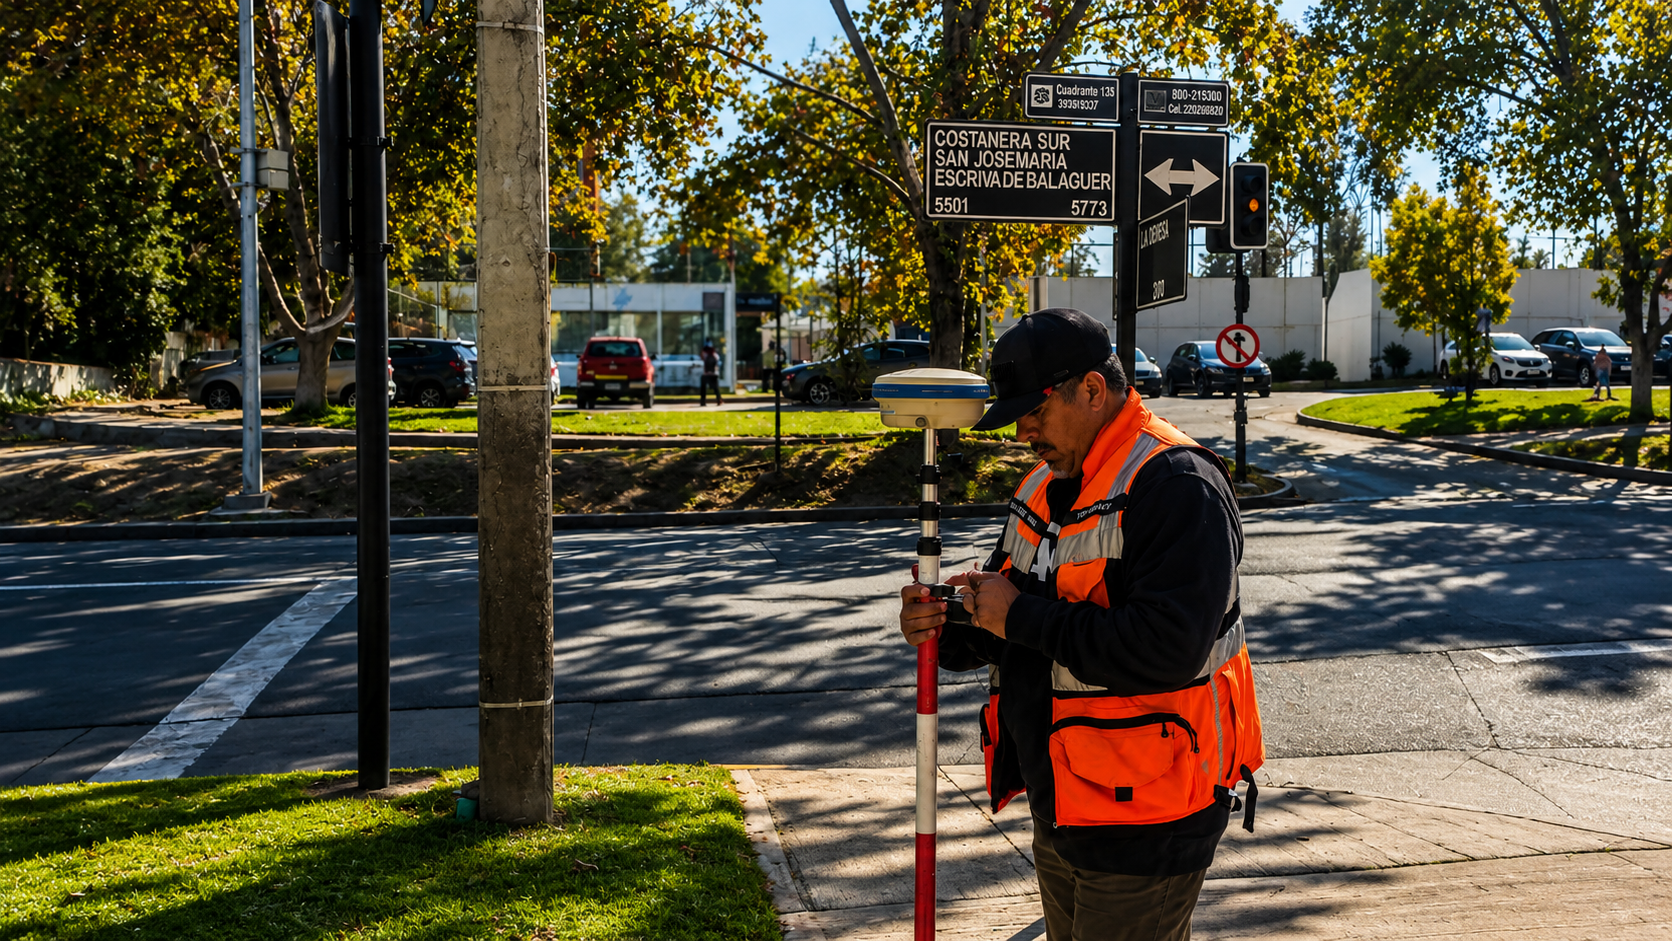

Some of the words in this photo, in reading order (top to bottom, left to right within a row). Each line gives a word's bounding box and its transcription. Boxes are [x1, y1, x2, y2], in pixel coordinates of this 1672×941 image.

[1056, 83, 1098, 97] Cuadrante
[934, 129, 1032, 150] COSTANERA
[1037, 132, 1071, 151] SUR
[934, 149, 969, 167] SAN
[973, 150, 1067, 170] JOSEMARIA
[934, 196, 968, 214] 5501
[1071, 199, 1108, 217] 5773
